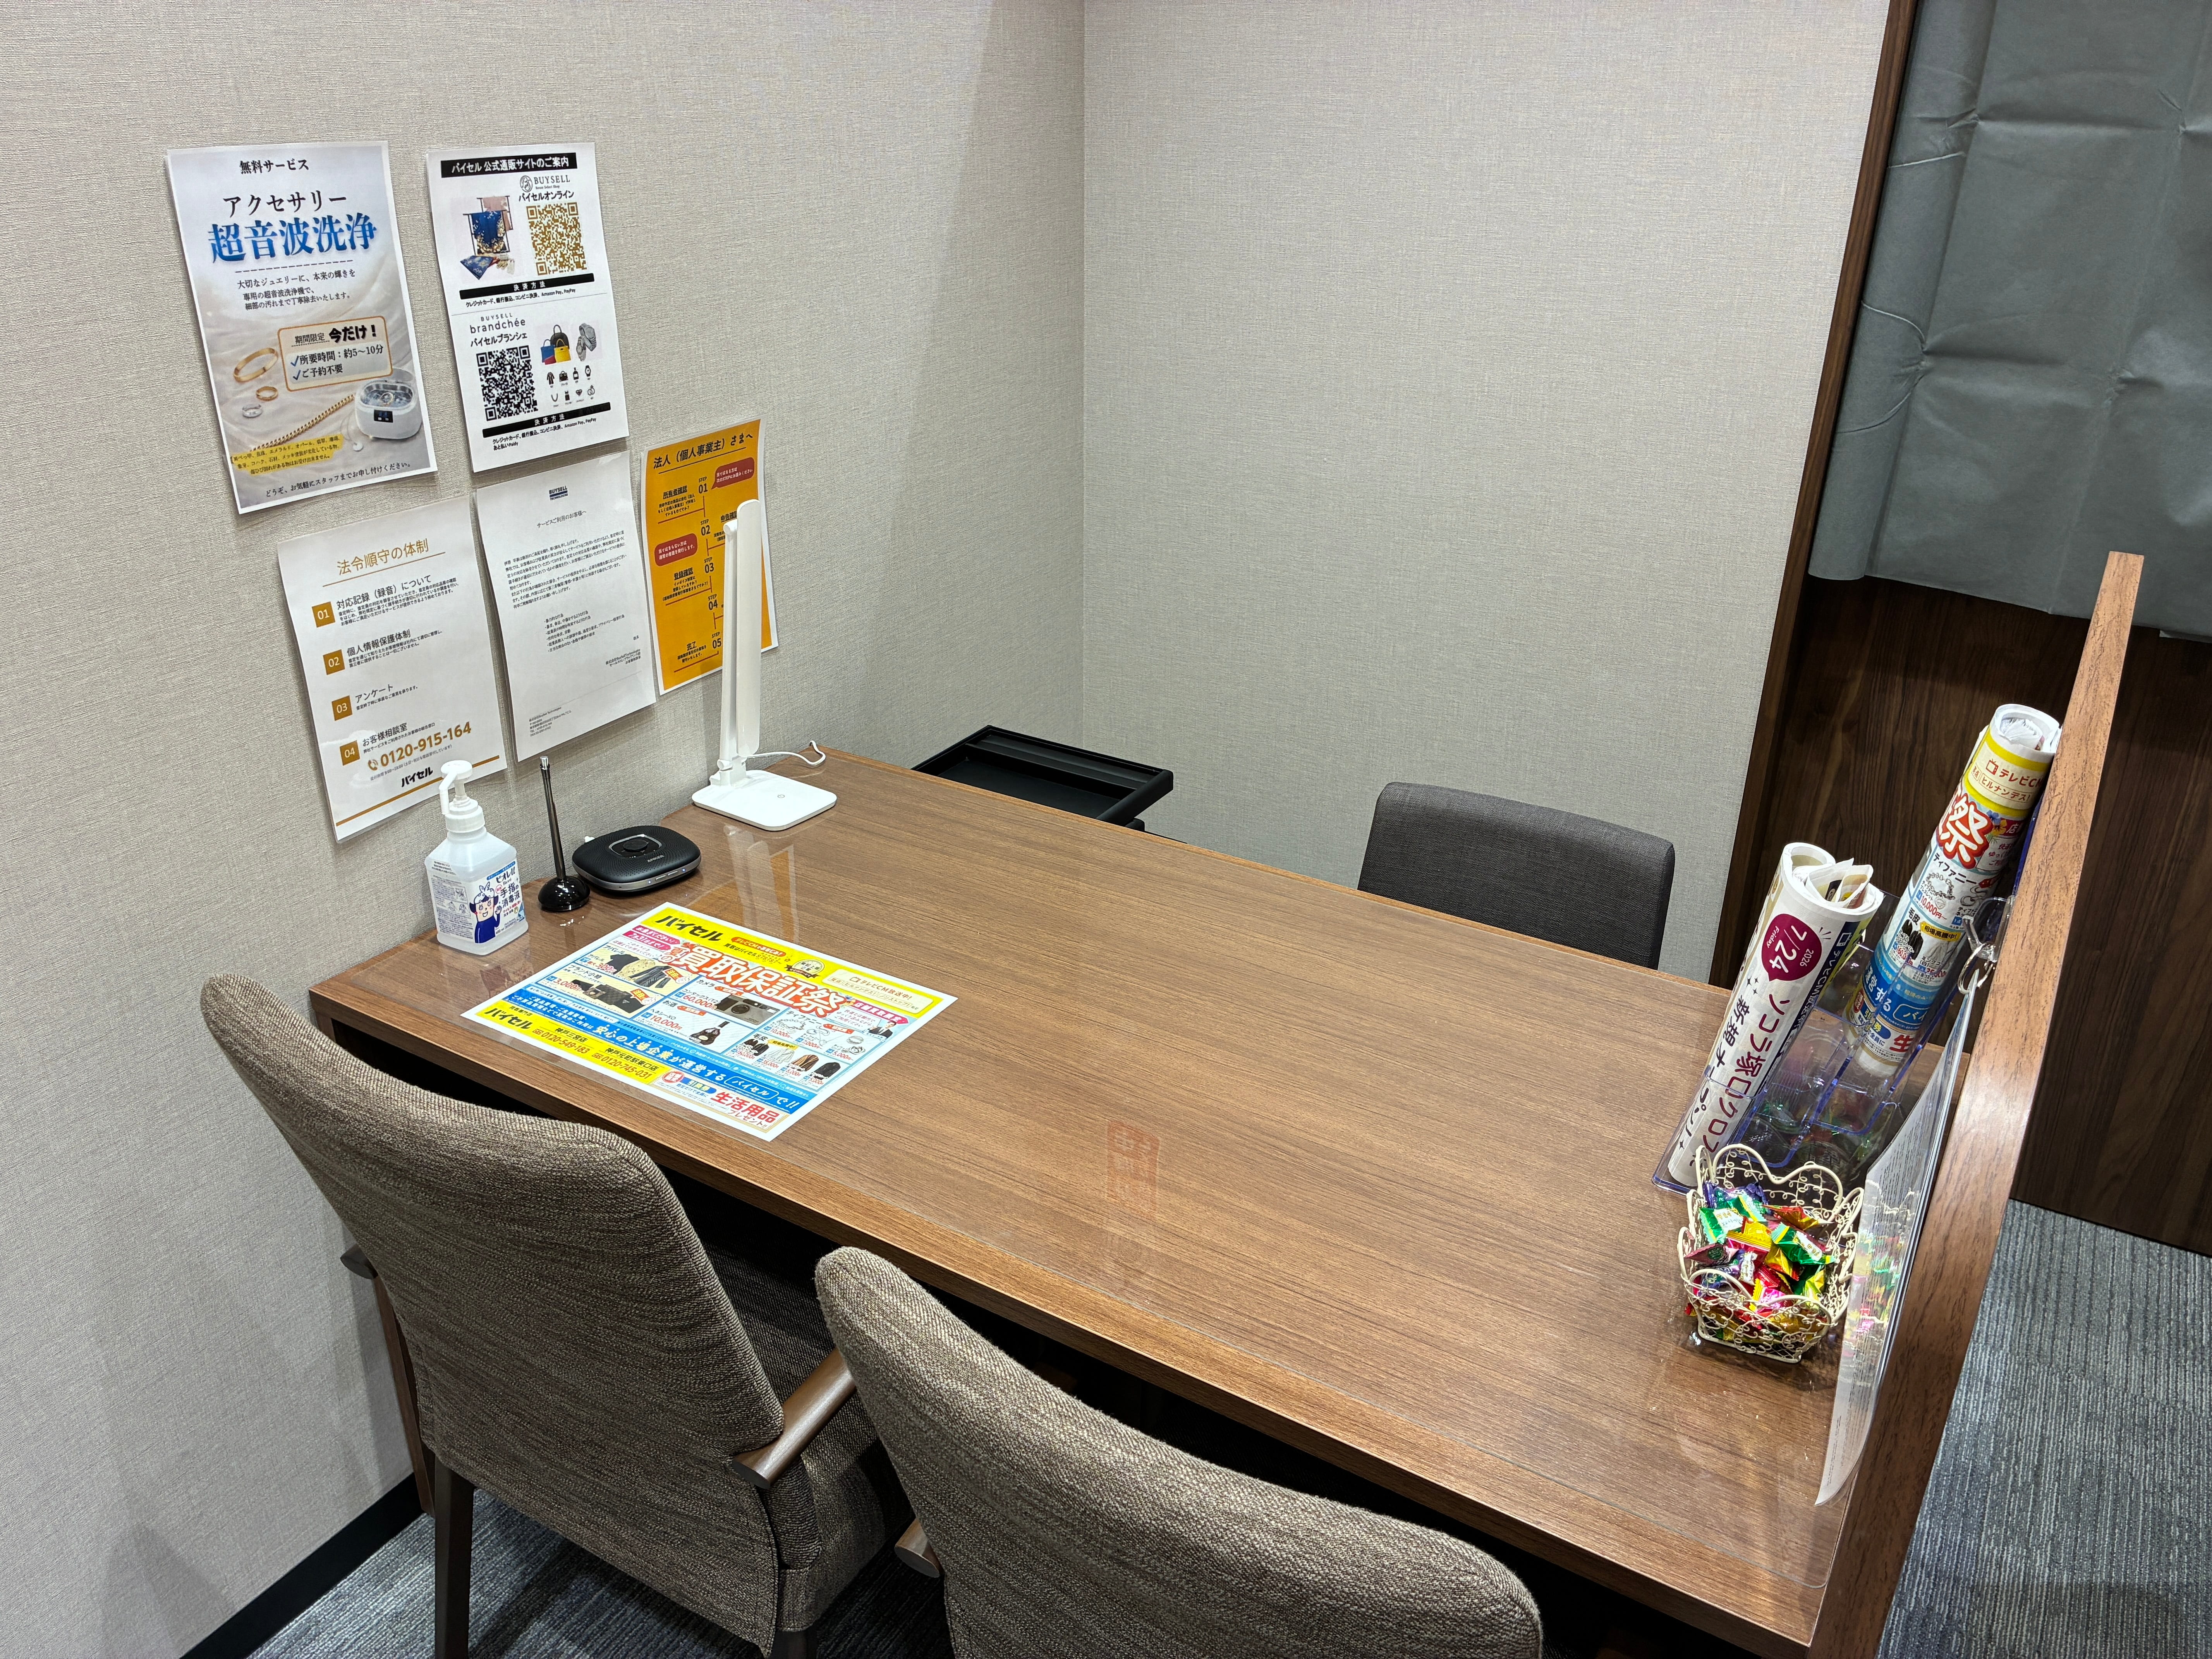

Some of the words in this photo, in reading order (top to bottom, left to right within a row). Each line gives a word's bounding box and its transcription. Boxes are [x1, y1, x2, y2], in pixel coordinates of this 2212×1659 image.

[240, 159, 309, 175] 無料サービス
[483, 155, 569, 173] 公式通販サイトのご案内
[534, 174, 570, 185] BUYSELL
[223, 190, 347, 218] アクセサリー
[208, 212, 378, 264] 超音波洗浄
[237, 269, 356, 290] 大切なジュエリーに、本来の輝きを
[469, 316, 526, 334] brandchée
[480, 312, 513, 322] BUYSELL
[294, 332, 325, 344] 期間限定
[302, 364, 343, 379] ご予約不要
[266, 462, 411, 497] どうぞ、お気軽にスタッフまでお申し付けください。
[698, 482, 708, 494] 01
[548, 485, 567, 495] BUYSELL
[701, 524, 710, 536] 02
[336, 538, 429, 576] 法令順守の体制
[705, 562, 714, 574] 03
[317, 608, 330, 620] 01
[709, 599, 718, 611] 04
[346, 629, 411, 658] 個人情報保護体制
[712, 637, 721, 649] 05
[328, 656, 340, 668] 02
[355, 682, 394, 704] アンケート
[336, 702, 348, 714] 03
[361, 721, 408, 747] お客様相談室
[344, 747, 356, 759] 04
[379, 720, 472, 768] 0120-915-164
[400, 766, 433, 788] バイセル
[647, 854, 665, 863] ANKER
[1933, 852, 1977, 884] ティファニー
[500, 882, 519, 898] 手指の
[502, 890, 521, 908] 消毒液
[1908, 907, 1921, 926] 毛皮
[654, 914, 728, 943] バイセル
[1767, 926, 1780, 948] Friday
[602, 945, 627, 955] アパレル
[1769, 925, 1807, 973] 7/24
[1800, 948, 1814, 967] 2026
[678, 944, 847, 1018] 買取保証祭
[696, 979, 716, 988] カメラ
[483, 1007, 536, 1030] バイセル
[785, 1011, 823, 1025] ティファニー
[539, 1032, 591, 1054] 0120-549-183
[553, 1027, 588, 1042] 神戸三宮店
[751, 1033, 769, 1041] 毛皮
[591, 1024, 731, 1082] 安心の上場企業が運営する
[731, 1079, 771, 1096] バイセル
[599, 1056, 653, 1079] 0120-745-031
[604, 1048, 659, 1071] 神戸元町駅東口店
[709, 1091, 782, 1123] 生活用品
